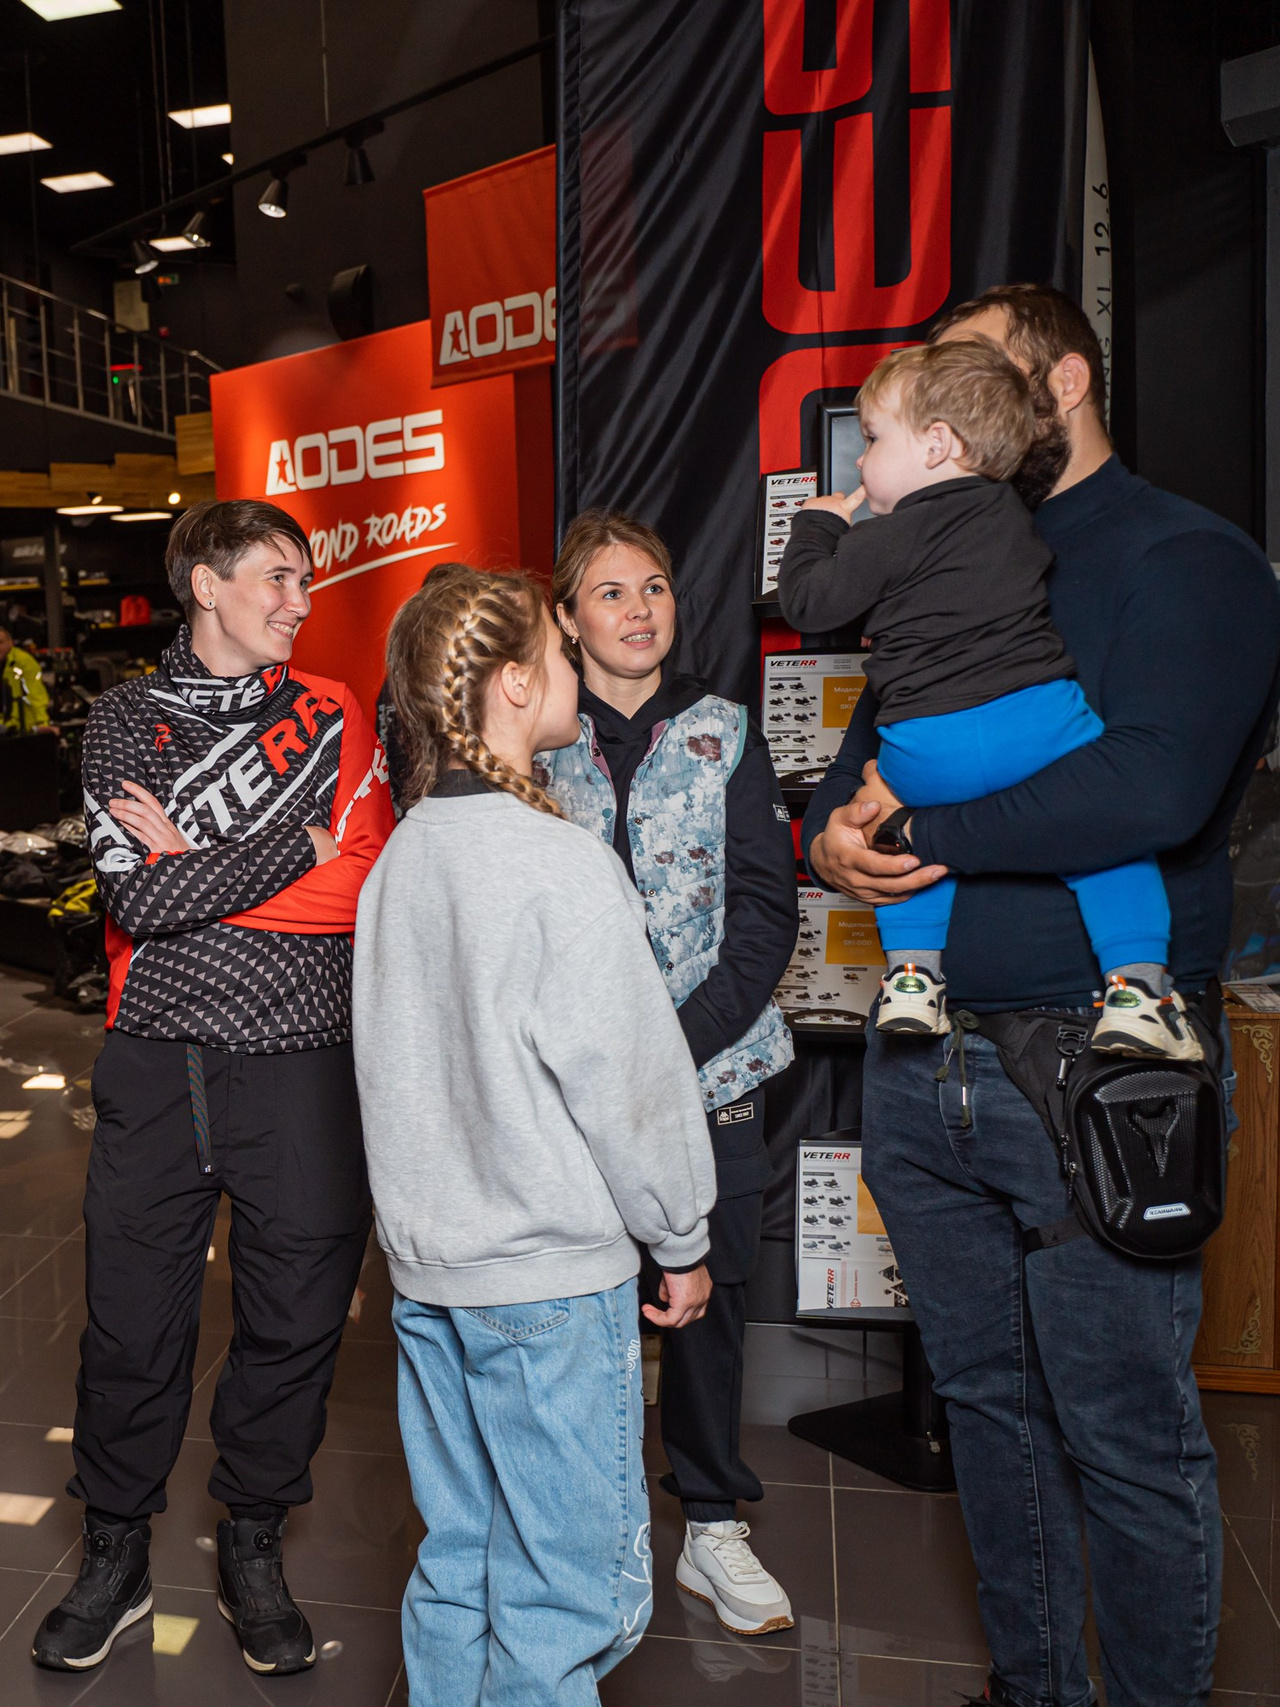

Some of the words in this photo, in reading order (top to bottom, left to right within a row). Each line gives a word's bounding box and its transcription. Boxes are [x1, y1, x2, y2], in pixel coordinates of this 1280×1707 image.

[266, 409, 445, 496] AODES
[363, 502, 448, 549] ROADS
[770, 659, 818, 667] VETERR
[803, 1151, 851, 1161] VETERR
